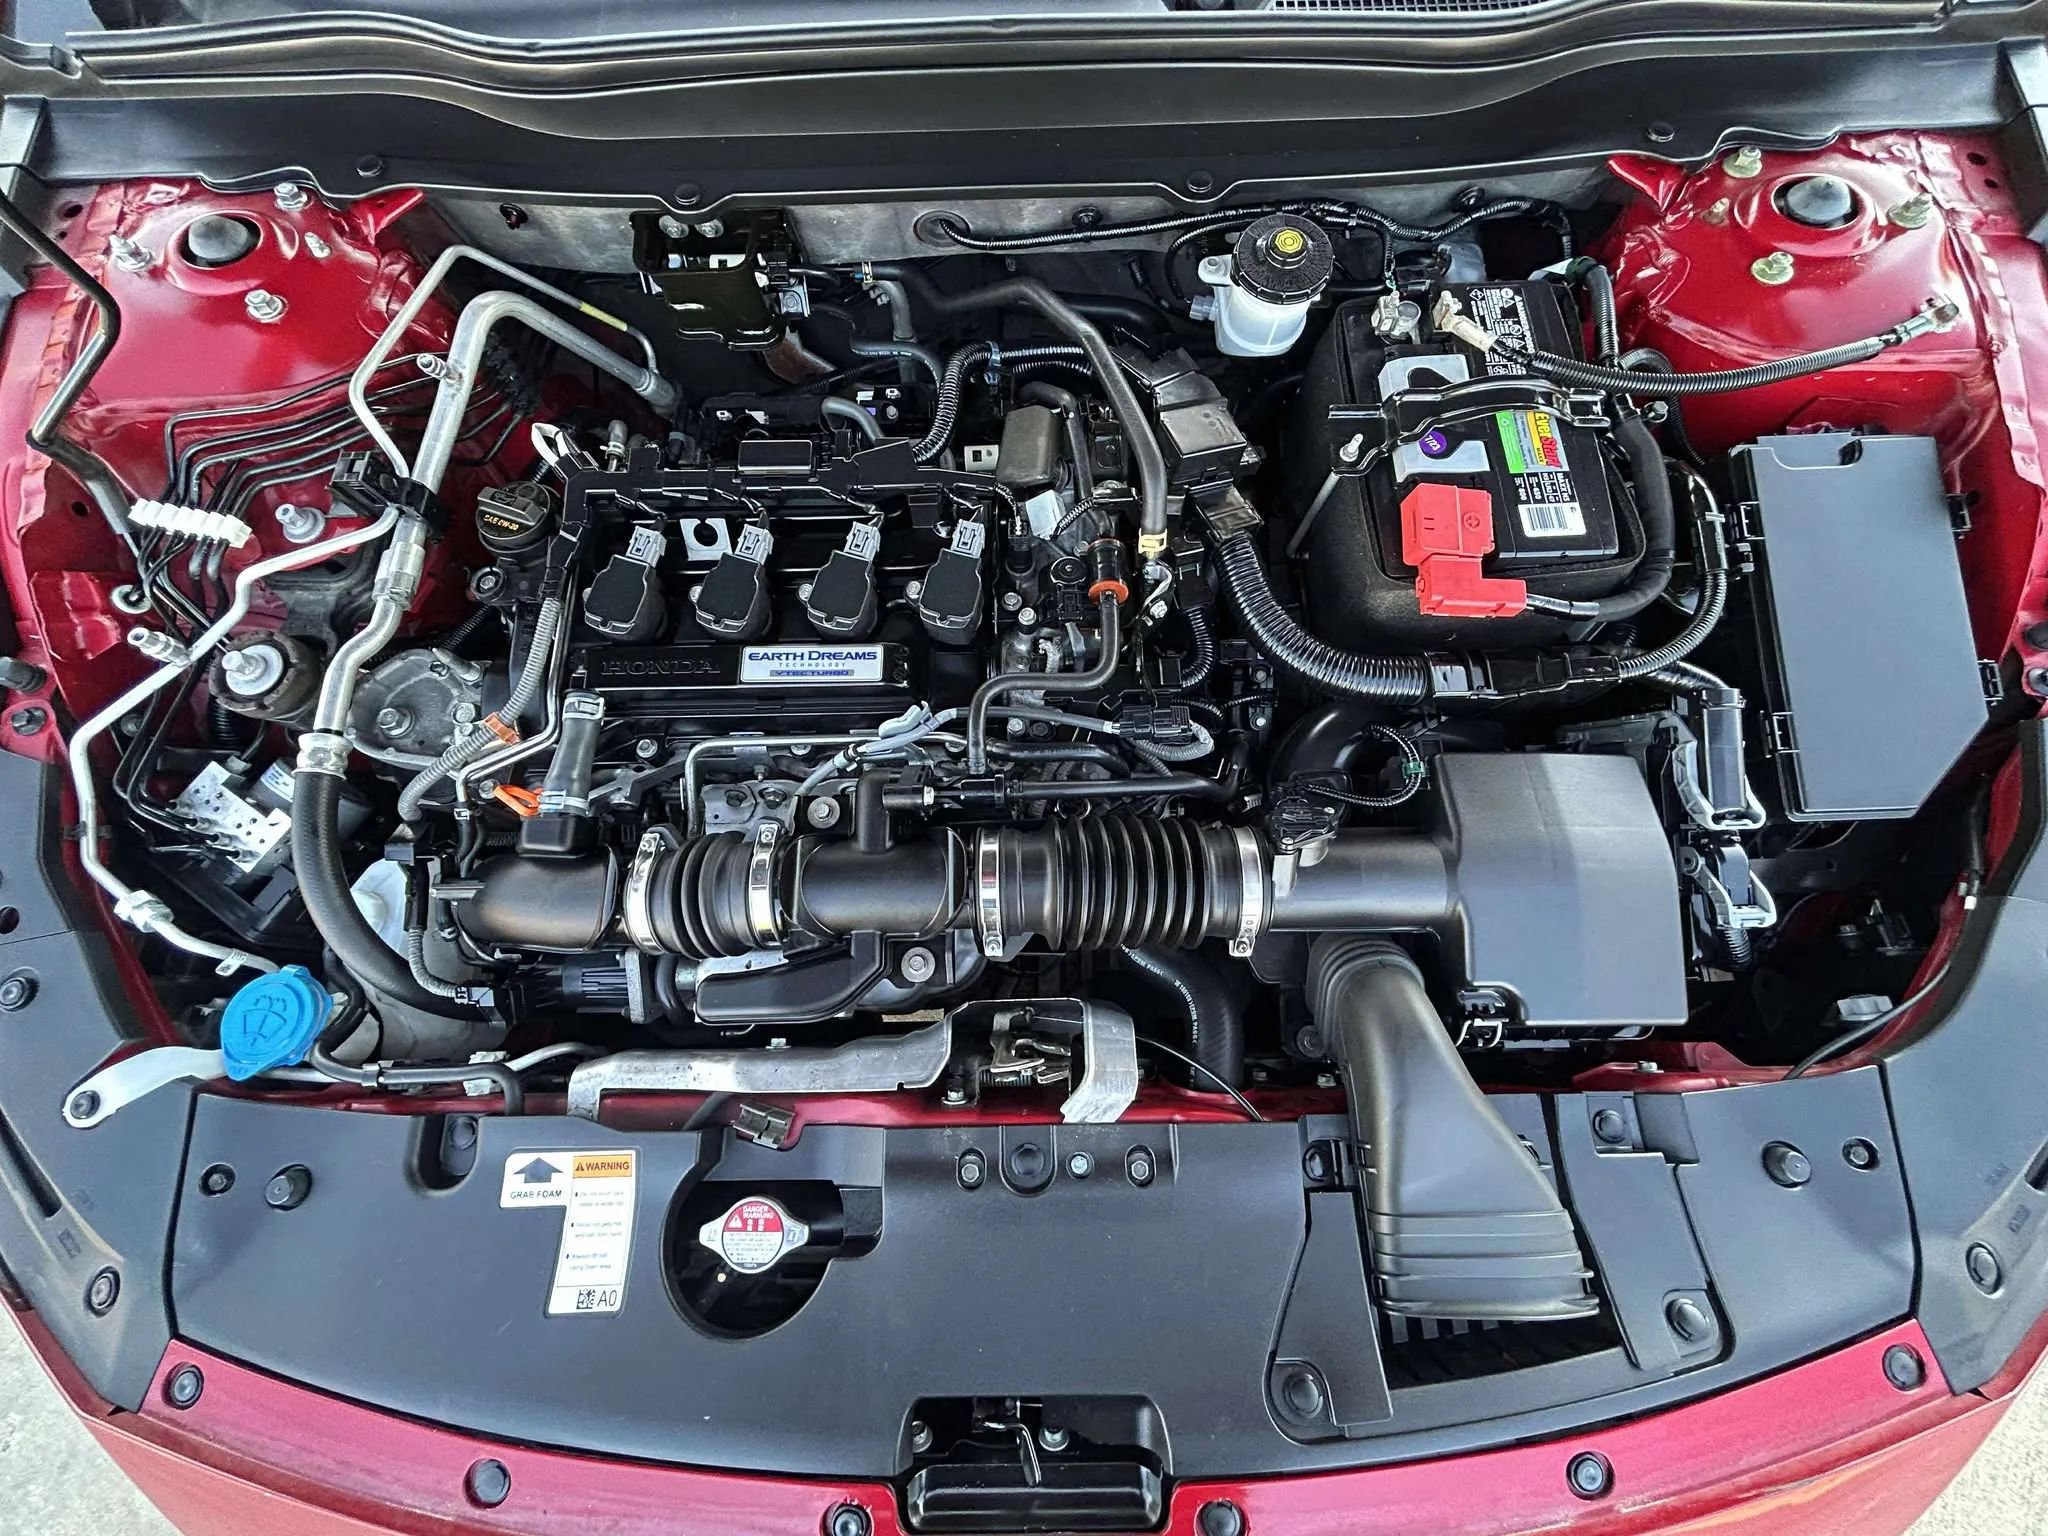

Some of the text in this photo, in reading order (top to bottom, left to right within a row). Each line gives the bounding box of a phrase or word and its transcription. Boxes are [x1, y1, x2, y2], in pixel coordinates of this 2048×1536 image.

[1517, 301, 1535, 354] DANGER/POISO
[1424, 434, 1441, 451] 7/23
[1534, 412, 1563, 468] EverStart
[1536, 447, 1544, 463] MAXX
[748, 650, 877, 662] EARTH DREAMS
[601, 658, 721, 675] HONDA
[585, 1161, 630, 1171] WARNING
[510, 1190, 562, 1199] GRAB FOAM
